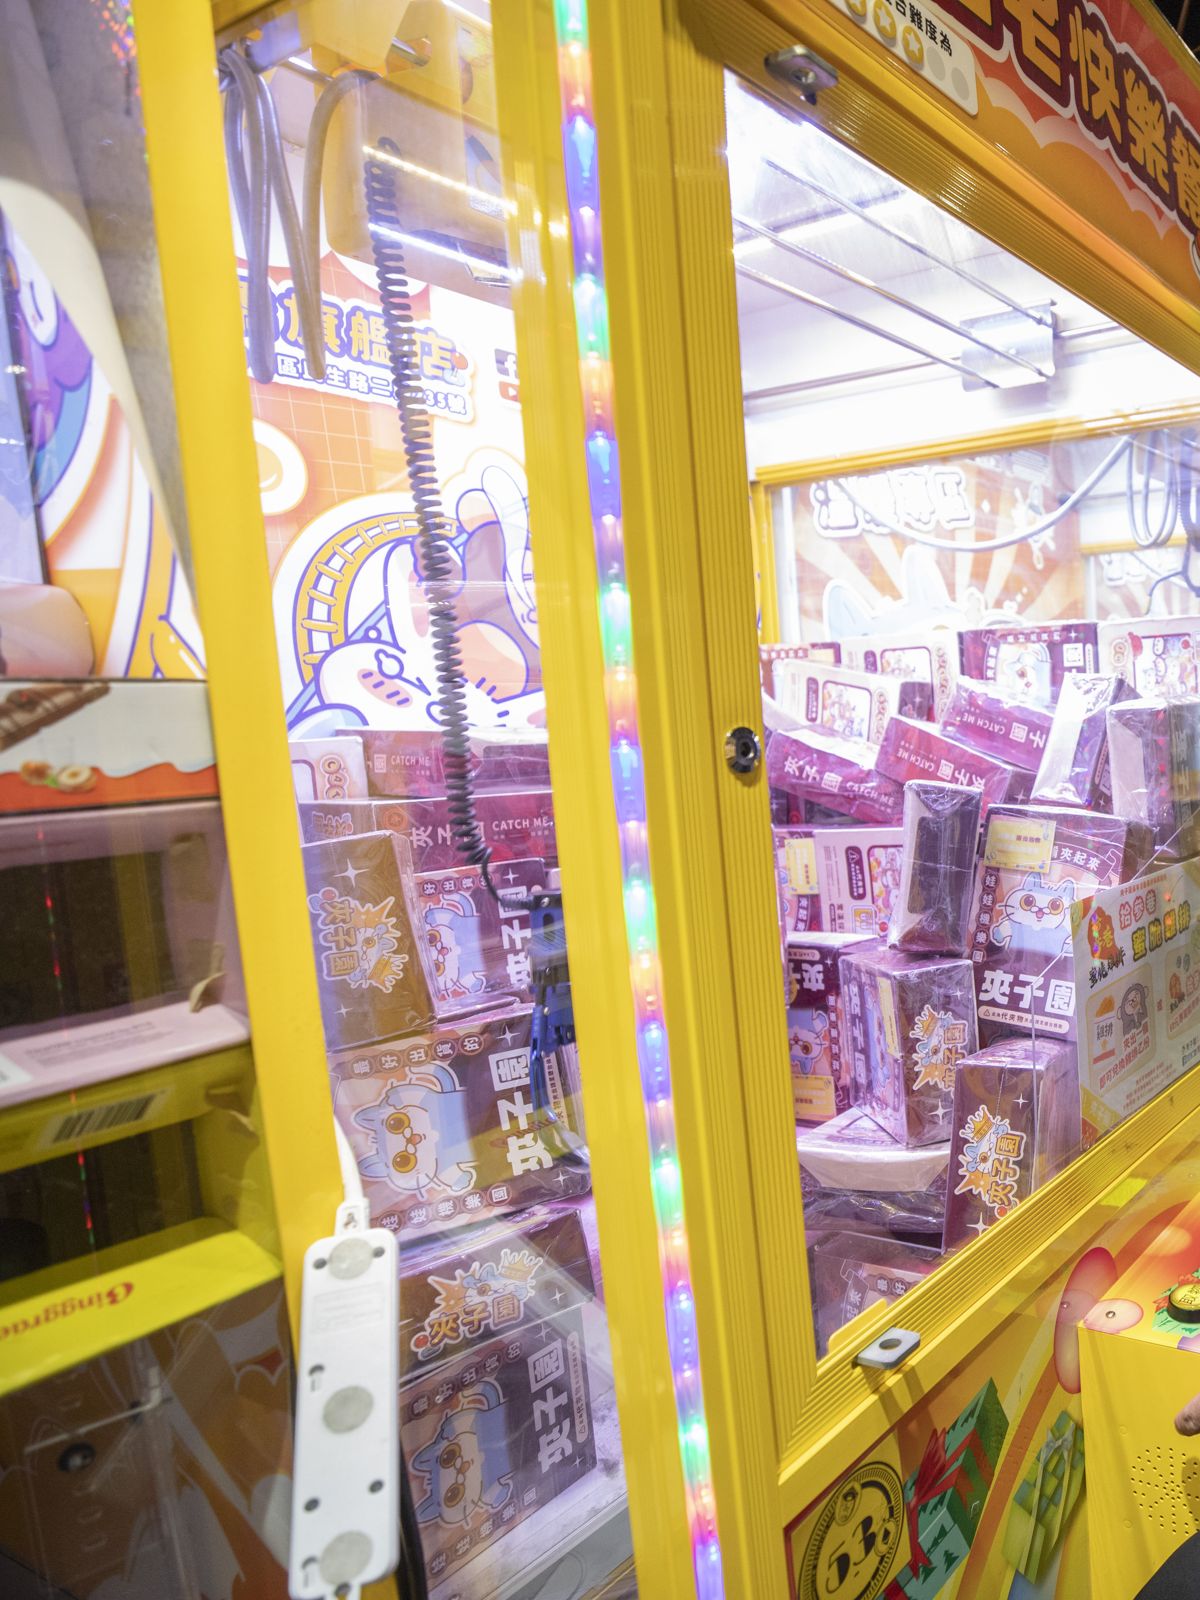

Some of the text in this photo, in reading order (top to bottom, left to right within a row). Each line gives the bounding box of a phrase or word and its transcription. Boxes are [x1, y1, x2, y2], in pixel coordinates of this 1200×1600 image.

[961, 712, 976, 725] ME
[976, 718, 1006, 735] CATCH
[390, 754, 416, 767] CATCH
[418, 754, 432, 767] ME
[896, 747, 908, 761] ME
[909, 751, 935, 772] CATCH
[846, 781, 878, 800] CATCH
[491, 818, 530, 831] CATCH
[533, 816, 551, 828] ME
[978, 969, 1077, 1017] 夾子園
[352, 1034, 483, 1075] 最好出貨的
[488, 1046, 553, 1176] 夾子園
[988, 1134, 1021, 1206] 夾子園
[381, 1185, 509, 1229] 娃娃機樂園
[429, 1296, 522, 1345] 夾子園
[526, 1338, 575, 1474] 夾子園
